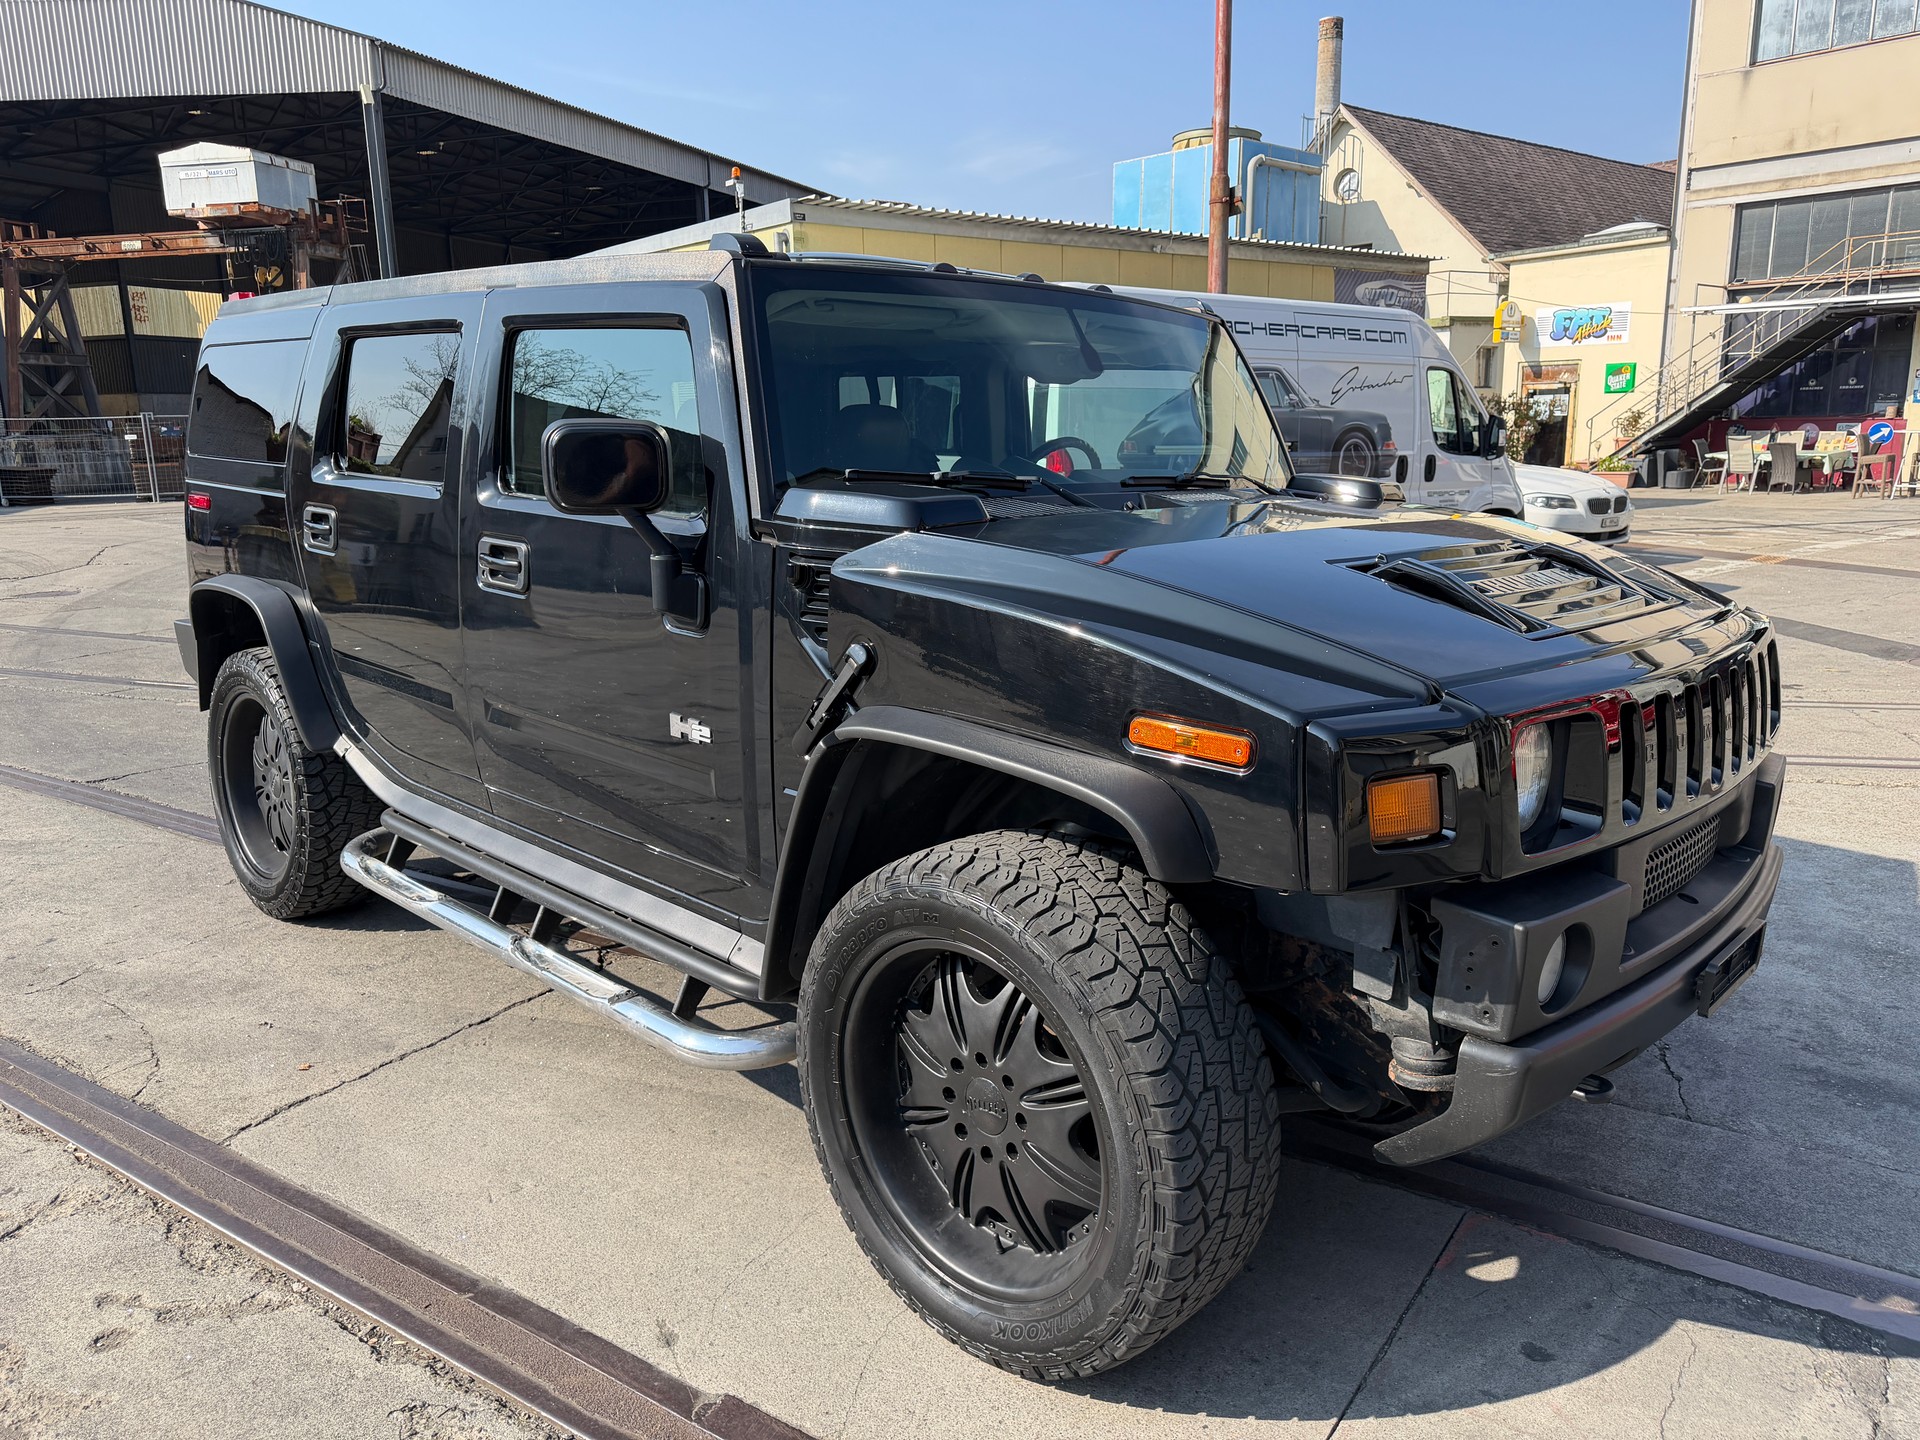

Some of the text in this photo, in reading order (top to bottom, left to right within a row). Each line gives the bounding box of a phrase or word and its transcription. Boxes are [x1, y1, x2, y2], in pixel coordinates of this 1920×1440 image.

[1550, 307, 1612, 341] FAT
[1571, 316, 1613, 345] Attack
[1606, 334, 1622, 342] INN
[1607, 372, 1631, 386] QUAKER
[1610, 381, 1626, 391] STATE
[823, 917, 889, 992] Dynapro
